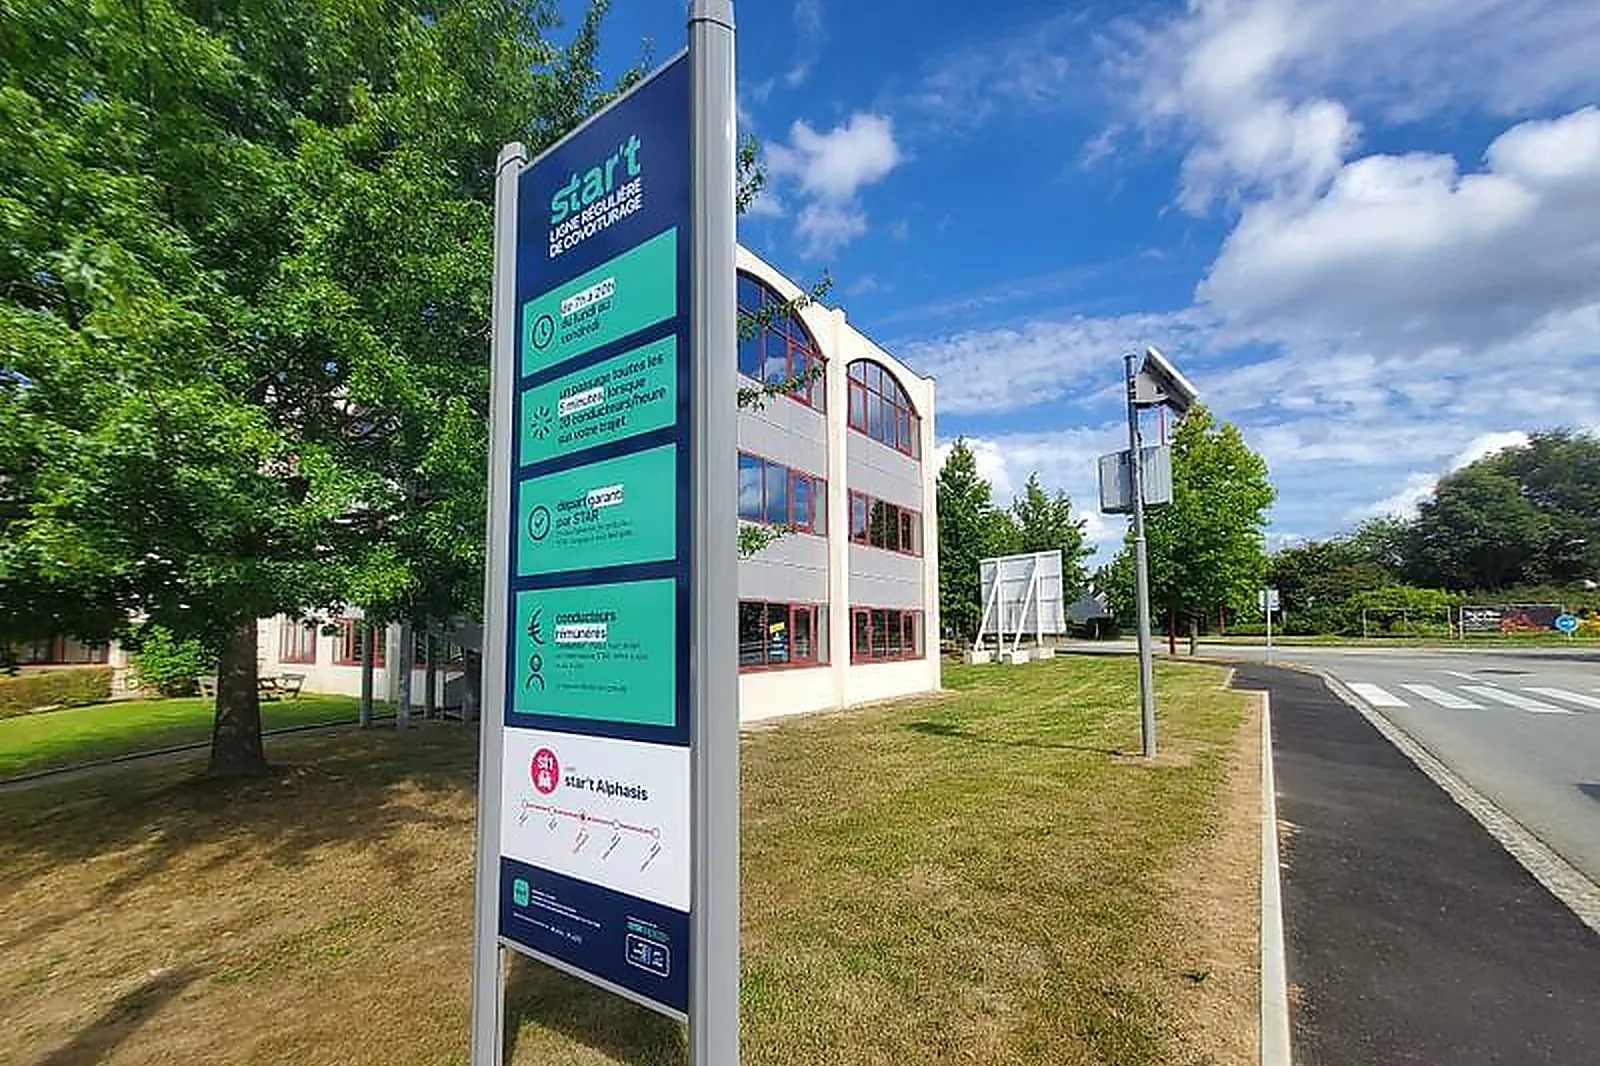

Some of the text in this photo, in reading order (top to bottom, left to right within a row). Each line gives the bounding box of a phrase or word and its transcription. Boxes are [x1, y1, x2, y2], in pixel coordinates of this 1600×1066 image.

[549, 193, 643, 258] DE COVOITURAGE
[549, 214, 580, 243] LIGNE
[596, 778, 649, 801] Alphasis
